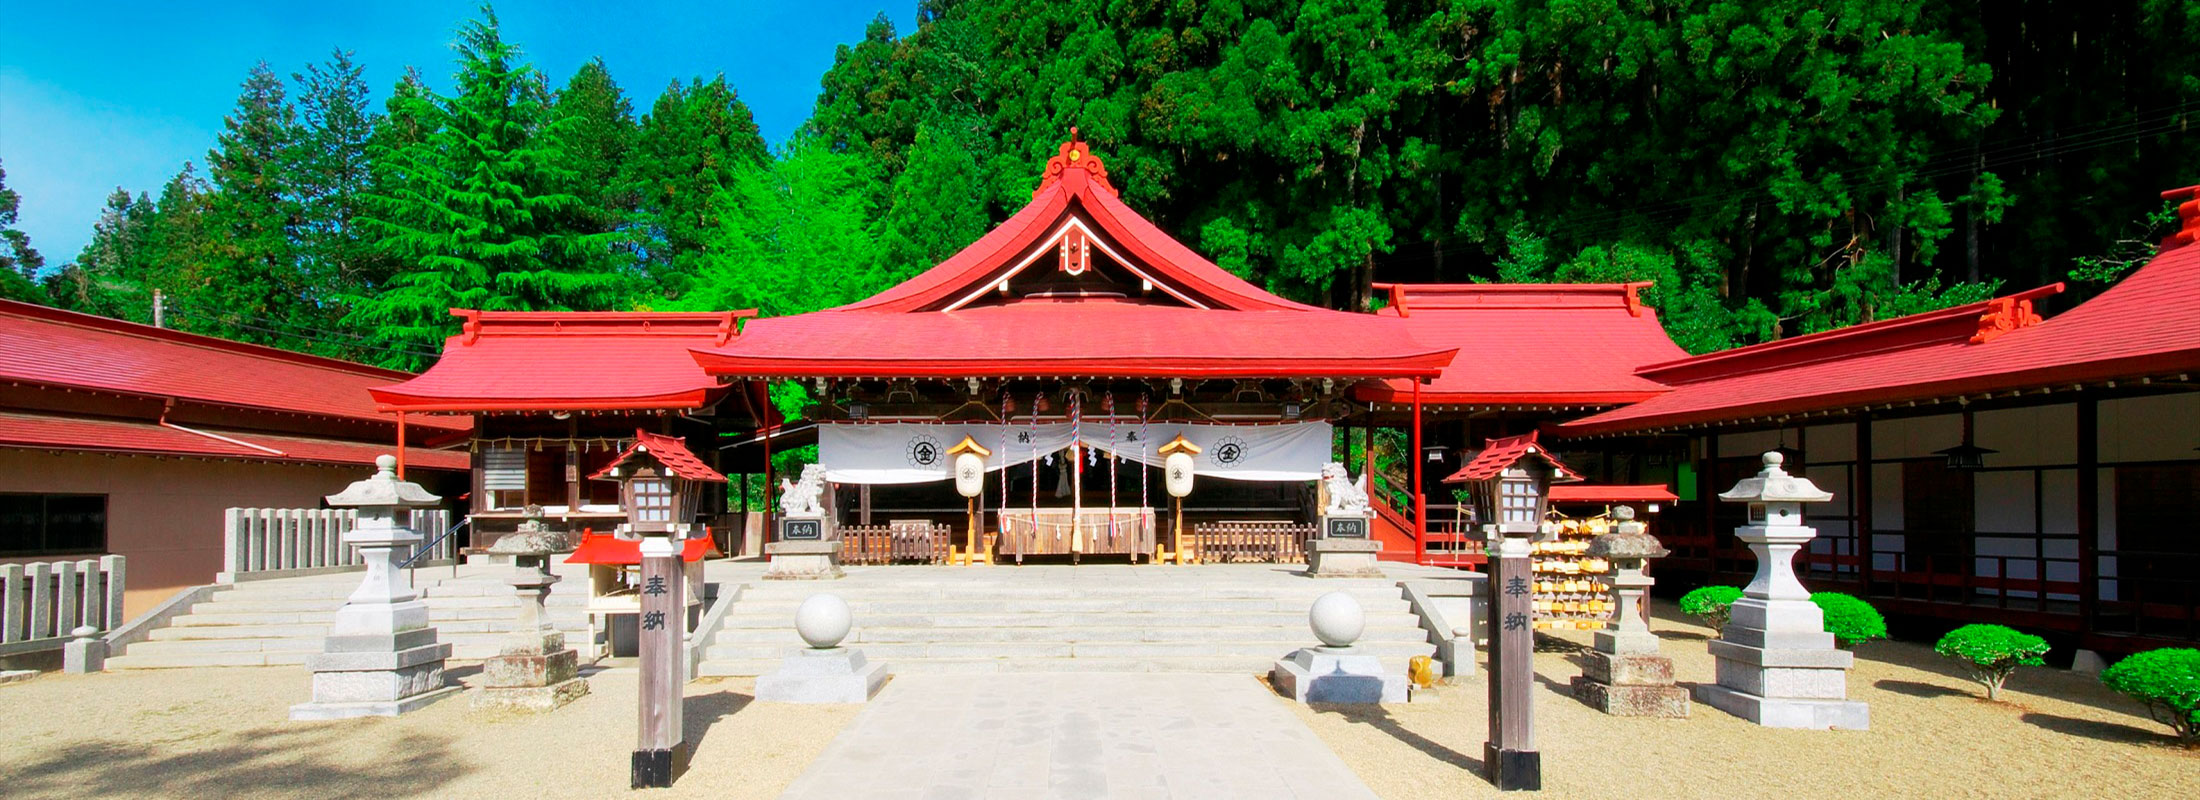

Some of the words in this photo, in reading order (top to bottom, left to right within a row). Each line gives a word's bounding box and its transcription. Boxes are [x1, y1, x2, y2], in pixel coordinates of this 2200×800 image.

[917, 445, 933, 461] 金
[1221, 446, 1237, 460] 金
[791, 524, 813, 535] 奉納
[1336, 522, 1357, 533] 奉納
[643, 574, 668, 630] 奉納
[1504, 575, 1529, 631] 奉納
